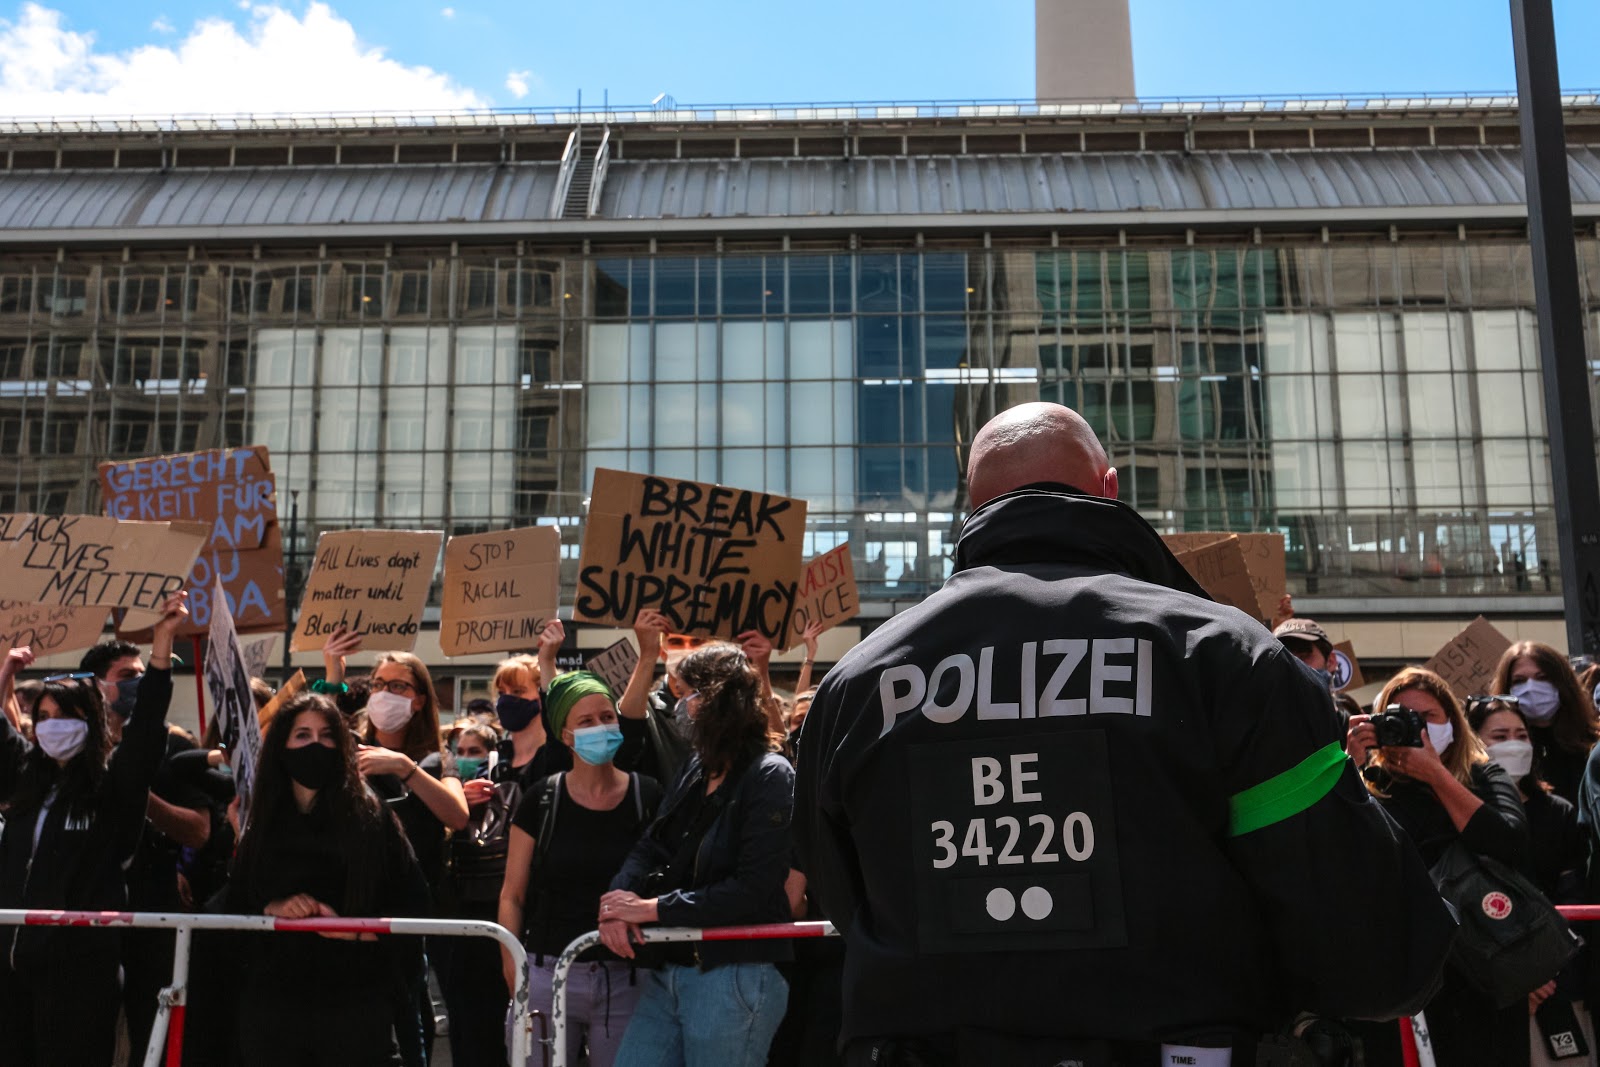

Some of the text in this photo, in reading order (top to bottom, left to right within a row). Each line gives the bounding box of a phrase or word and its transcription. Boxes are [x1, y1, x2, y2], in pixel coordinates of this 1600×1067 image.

[106, 451, 253, 492] GERECHT
[217, 476, 274, 513] FÜR
[640, 476, 791, 542] BREAK
[210, 513, 265, 546] AM
[23, 543, 114, 572] LIVES
[190, 548, 240, 584] OU
[317, 546, 339, 571] All
[345, 545, 380, 568] Lives
[464, 540, 515, 571] STOP
[798, 546, 848, 598] ACIST
[39, 571, 184, 609] MATTER
[312, 580, 403, 601] matter until
[462, 579, 521, 604] RACIAL
[577, 565, 798, 651] SUPREMACY
[793, 582, 851, 634] OLICE
[353, 609, 396, 635] Lives
[397, 614, 417, 636] do
[455, 618, 546, 647] PROFILING
[556, 653, 583, 665] mad
[1434, 636, 1480, 679] CISM
[879, 638, 1152, 739] POLIZEI
[971, 753, 1042, 806] BE
[931, 811, 1095, 869] 34220
[1171, 1055, 1197, 1065] TIME:
